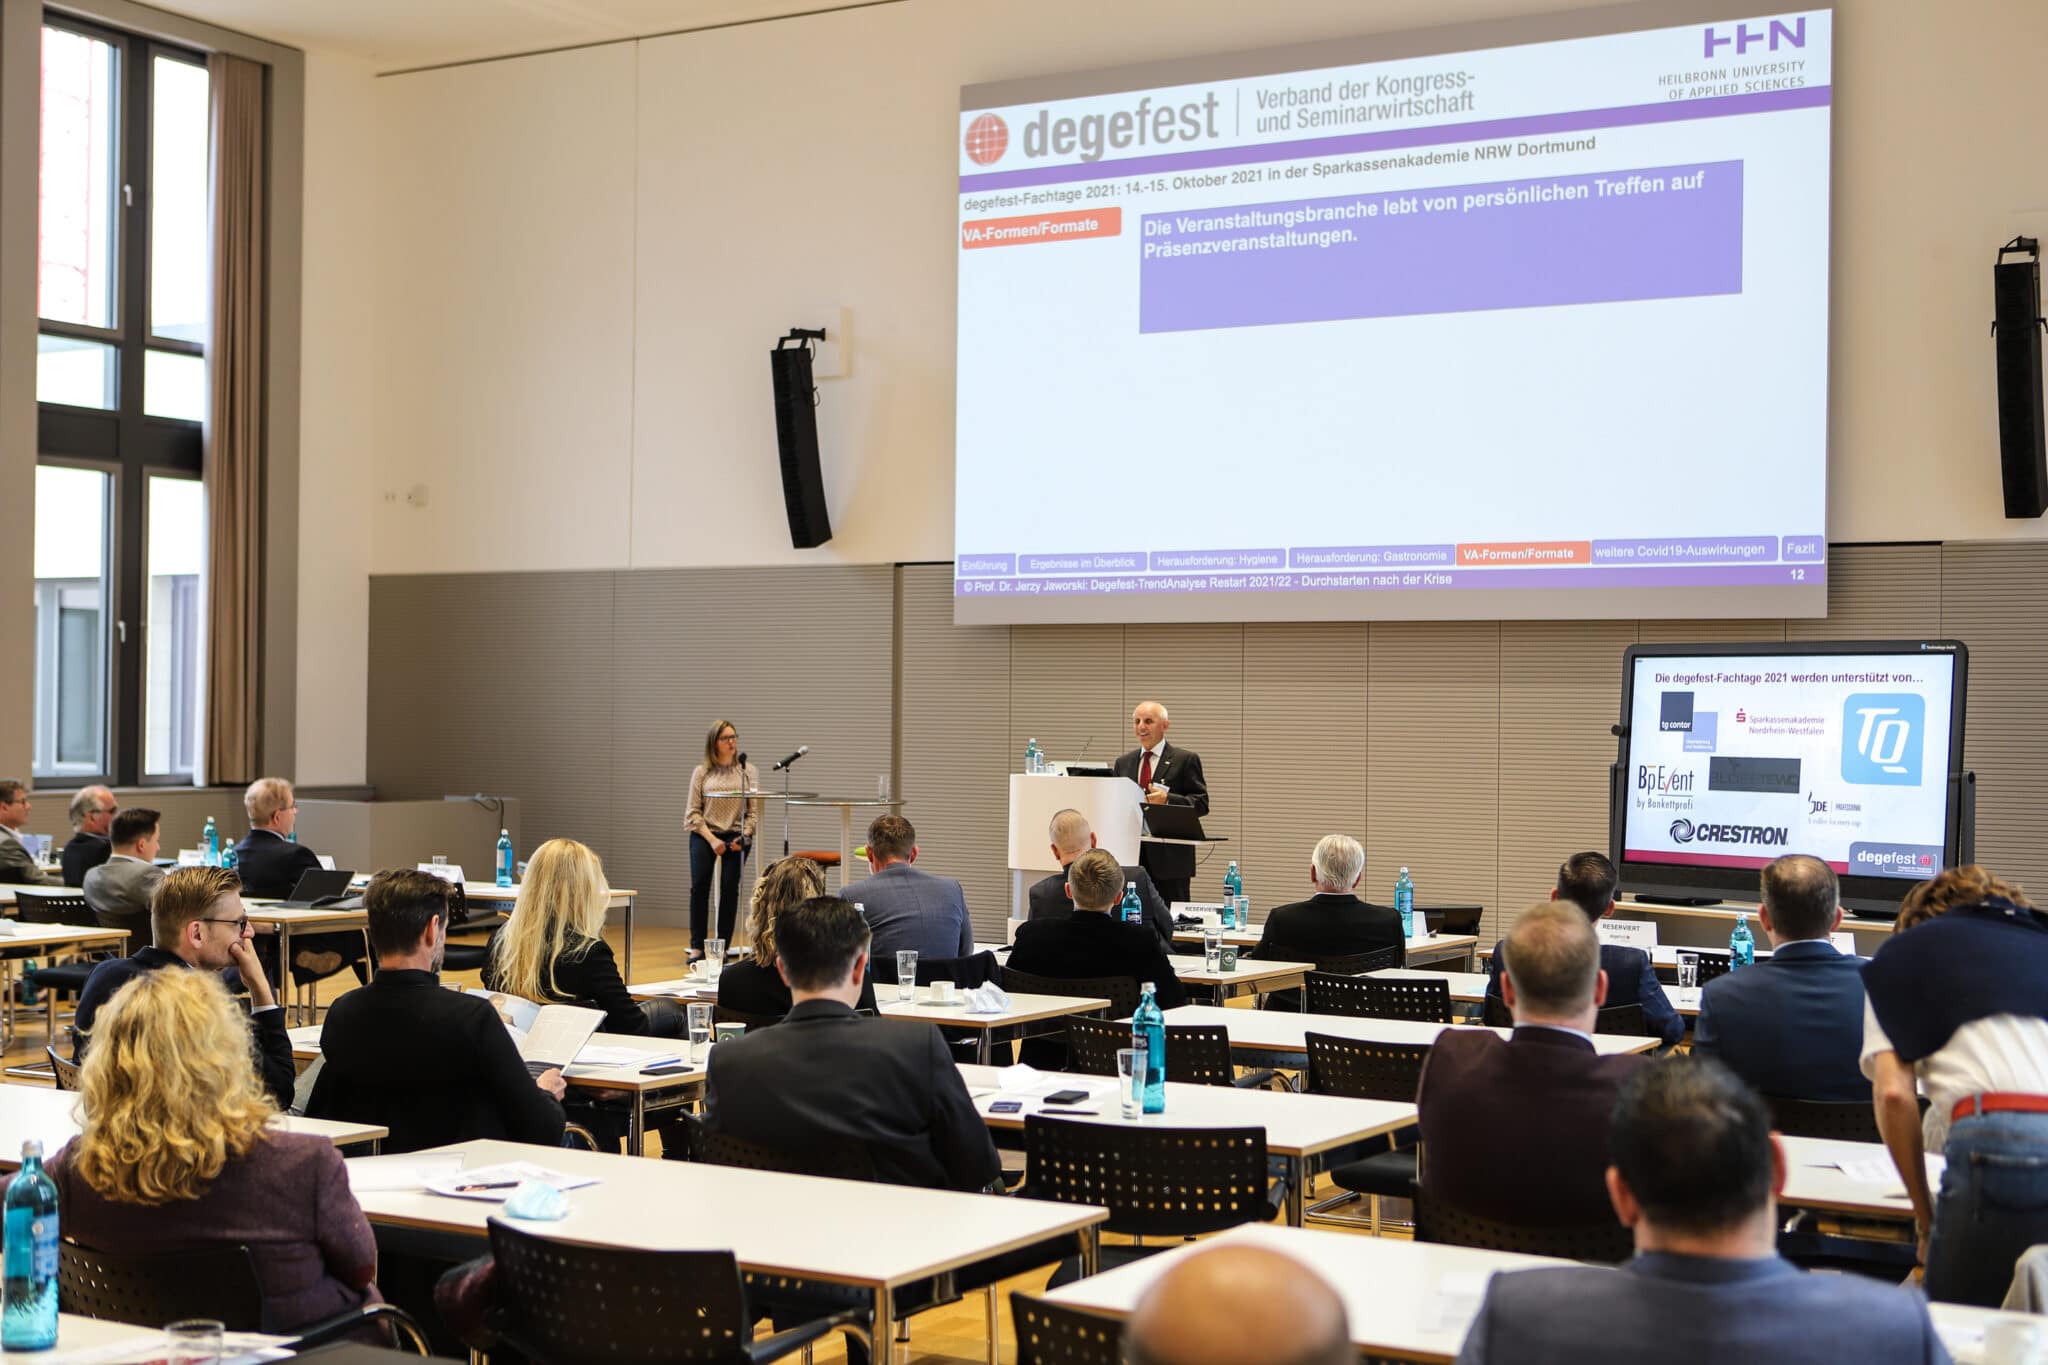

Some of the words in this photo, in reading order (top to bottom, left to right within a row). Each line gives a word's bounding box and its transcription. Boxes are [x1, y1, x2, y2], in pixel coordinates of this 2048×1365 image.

[1658, 68, 1727, 86] HEILBRONN
[1733, 60, 1806, 78] UNIVERSITY
[1256, 83, 1332, 110] Verband
[1338, 78, 1370, 103] der
[1376, 71, 1475, 100] Kongress-
[1669, 88, 1687, 101] OF
[1689, 83, 1739, 99] APPLIED
[1745, 76, 1805, 93] SCIENCES
[1256, 112, 1291, 135] und
[1297, 91, 1475, 130] Seminarwirtschaft
[1023, 92, 1219, 162] degefest
[964, 188, 1083, 211] degefest-Fachtage
[1086, 183, 1121, 199] 2021:
[1125, 178, 1169, 196] 14.-15.
[1172, 173, 1228, 191] Oktober
[1232, 169, 1263, 185] 2021
[1268, 166, 1281, 181] in
[1285, 163, 1308, 179] der
[1313, 148, 1470, 178] Sparkassenakademie
[1475, 144, 1512, 161] NRW
[1518, 136, 1596, 156] Dortmund
[1144, 218, 1171, 238] Die
[1176, 202, 1379, 235] Veranstaltungsbranche
[1383, 196, 1417, 216] lebt
[1423, 196, 1458, 213] von
[1464, 181, 1589, 213] persönlichen
[1595, 175, 1664, 197] Treffen
[1671, 171, 1705, 191] auf
[963, 217, 1099, 243] VA-Formen/Formate
[1144, 228, 1358, 260] Präsenzveranstaltungen.
[1383, 549, 1448, 562] Gastronomie
[1463, 547, 1574, 561] VA-Formen/Formate
[1595, 546, 1635, 559] weitere
[1637, 543, 1765, 558] Covid19-Auswirkungen
[1786, 542, 1816, 555] Fazit
[962, 559, 1008, 572] Einführung
[1030, 559, 1078, 571] Ergebnisse
[1094, 557, 1136, 568] Überblick
[1239, 554, 1278, 566] Hygiene
[1790, 568, 1805, 580] 12
[974, 581, 995, 593] Prof.
[999, 581, 1012, 592] Dr.
[1015, 580, 1041, 593] Jerzy
[1043, 579, 1088, 592] Jaworski:
[1091, 576, 1206, 593] Degefest-TrendAnalyse
[1209, 577, 1247, 589] Restart
[1249, 575, 1291, 588] 2021/22
[1302, 574, 1370, 587] Durchstarten
[1373, 574, 1400, 586] nach
[1403, 573, 1422, 586] der
[1424, 573, 1453, 585] Krise
[1655, 673, 1671, 683] Die
[1673, 672, 1762, 686] degefest-Fachtage
[1764, 672, 1788, 683] 2021
[1791, 672, 1829, 683] werden
[1831, 672, 1889, 684] unterstützt
[1749, 714, 1825, 726] Sparkassenakademie
[1749, 726, 1825, 736] Nordrhein-Westfalen
[1854, 707, 1911, 774] TQ
[1636, 798, 1646, 810] by
[1696, 823, 1789, 846] CRESTRON
[1857, 850, 1917, 866] degefest
[1602, 923, 1641, 932] RESERVIERT
